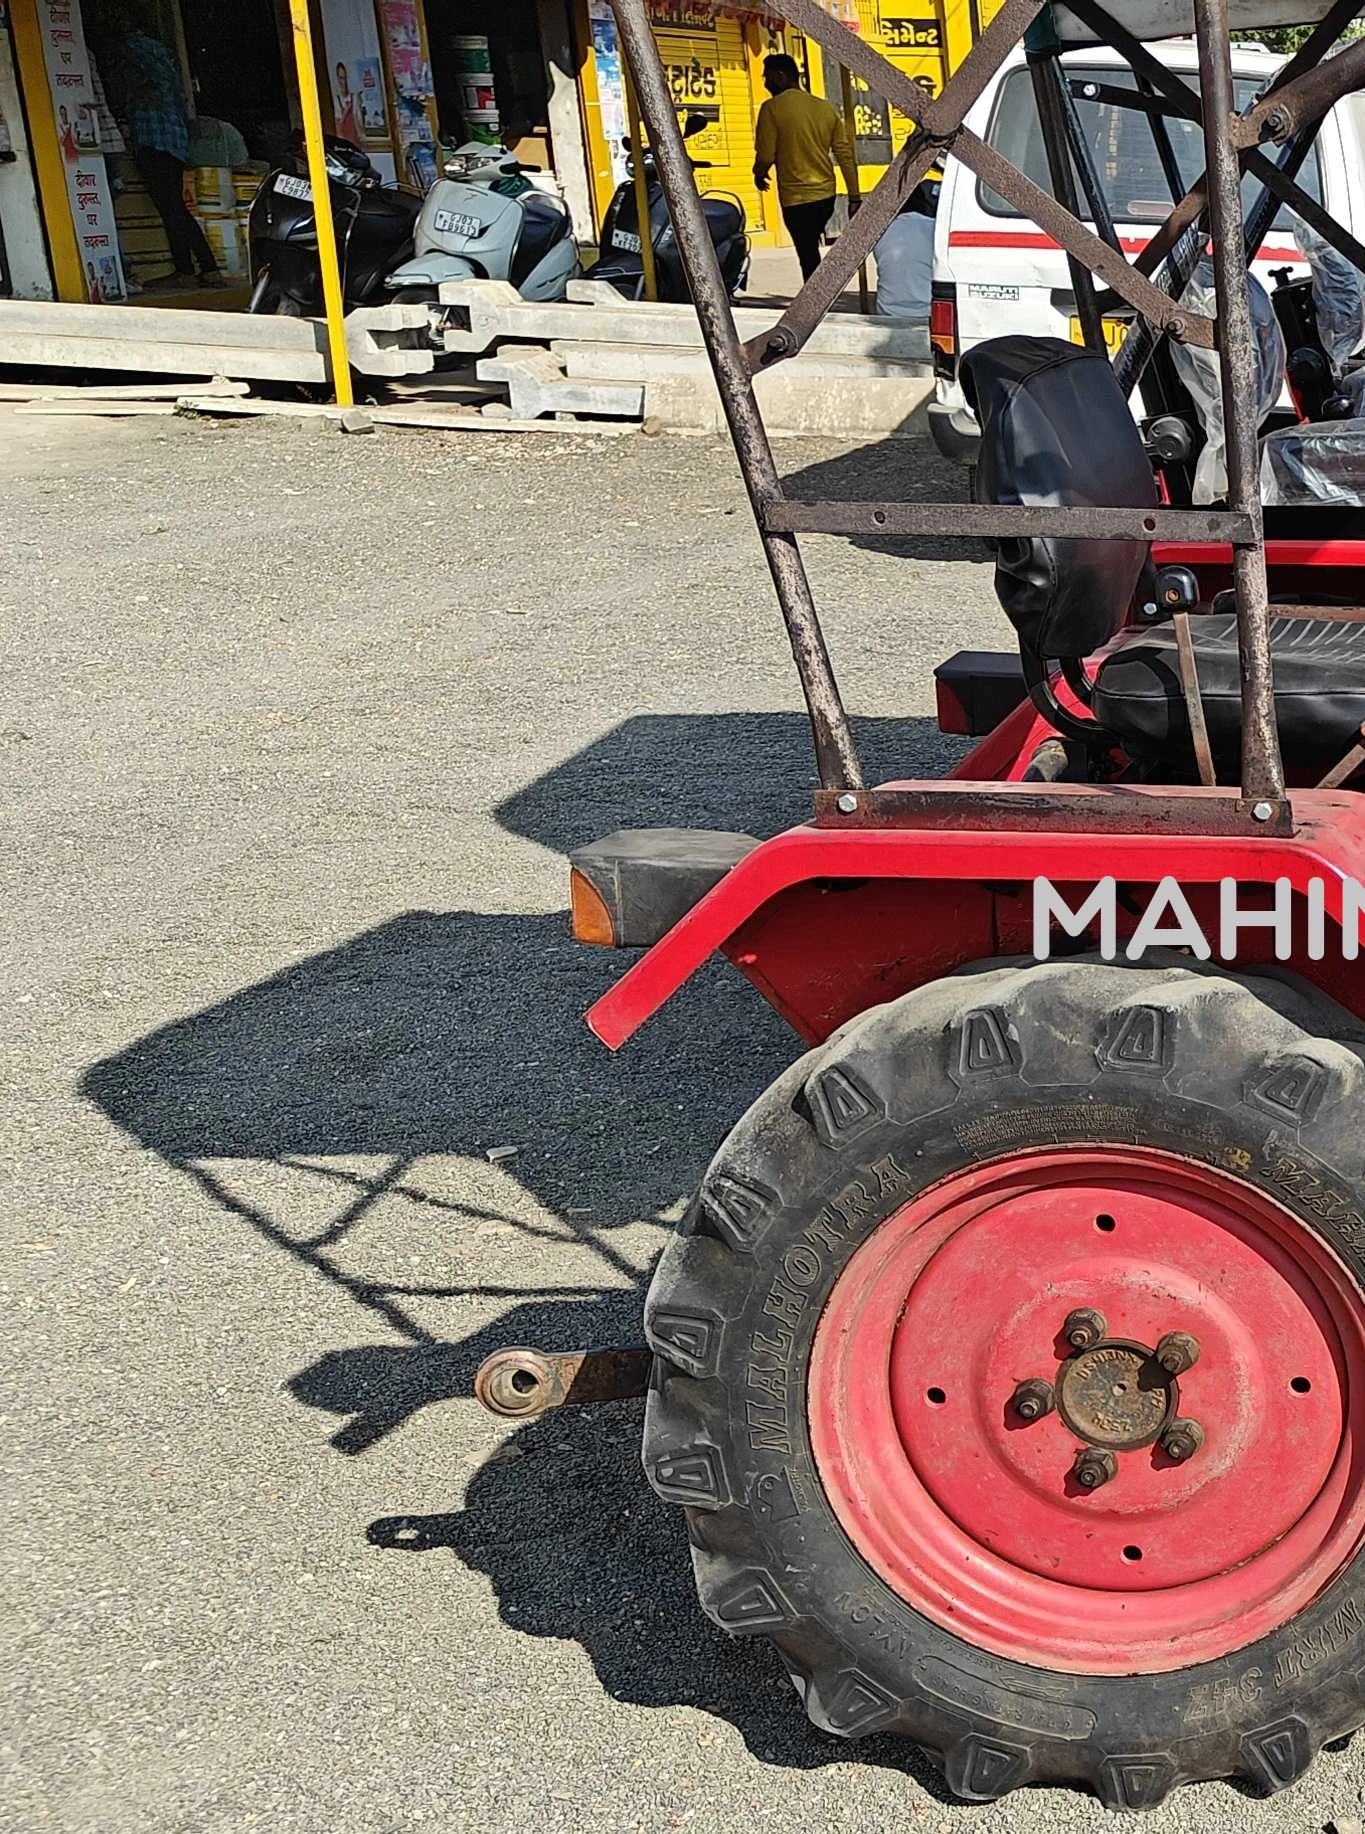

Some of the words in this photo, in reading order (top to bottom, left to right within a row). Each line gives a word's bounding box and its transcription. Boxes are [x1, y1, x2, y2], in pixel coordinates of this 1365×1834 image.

[970, 284, 1017, 293] MARUTI
[970, 291, 1018, 300] SUZUKI
[745, 1152, 912, 1455] MALHOTRA
